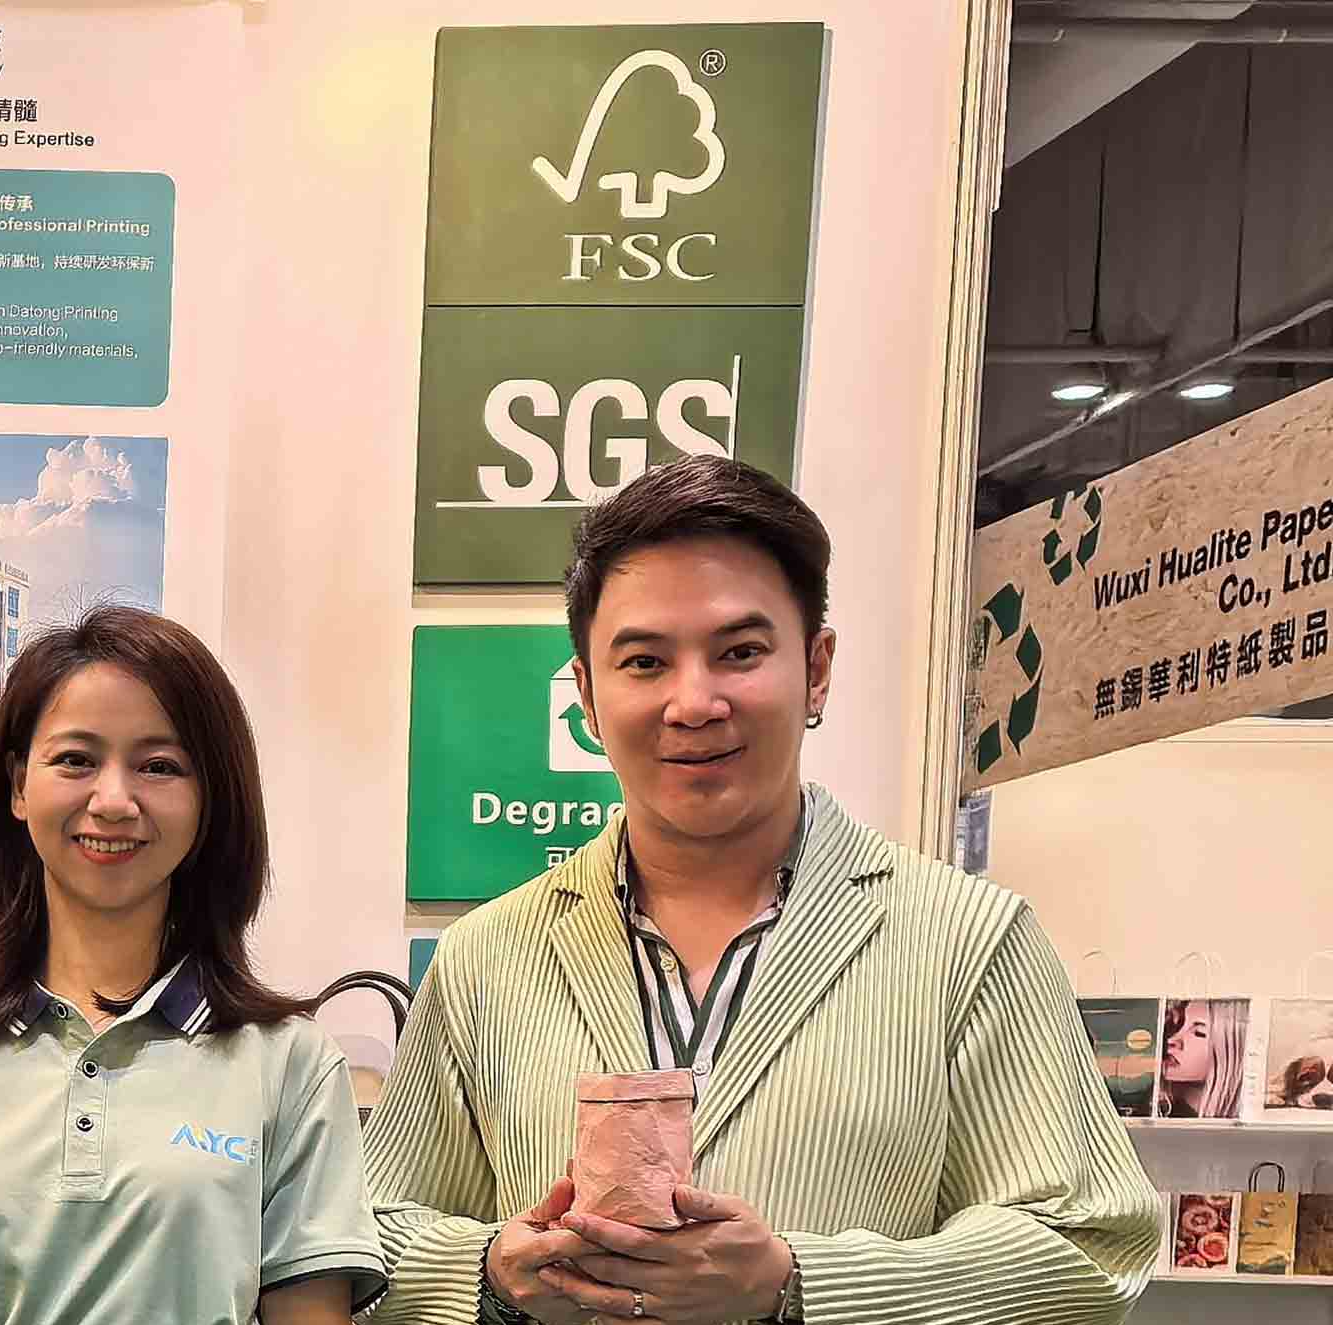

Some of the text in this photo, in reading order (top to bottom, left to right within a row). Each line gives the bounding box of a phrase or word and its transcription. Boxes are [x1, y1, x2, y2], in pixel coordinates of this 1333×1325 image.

[14, 131, 95, 148] Expertise
[86, 219, 151, 236] Printing
[561, 232, 719, 282] FSC
[10, 304, 61, 321] Datong
[64, 305, 119, 322] Printing
[476, 378, 735, 504] SGS
[1094, 499, 1333, 611] Wuxi Hualite Pape
[1283, 541, 1333, 594] Ltd
